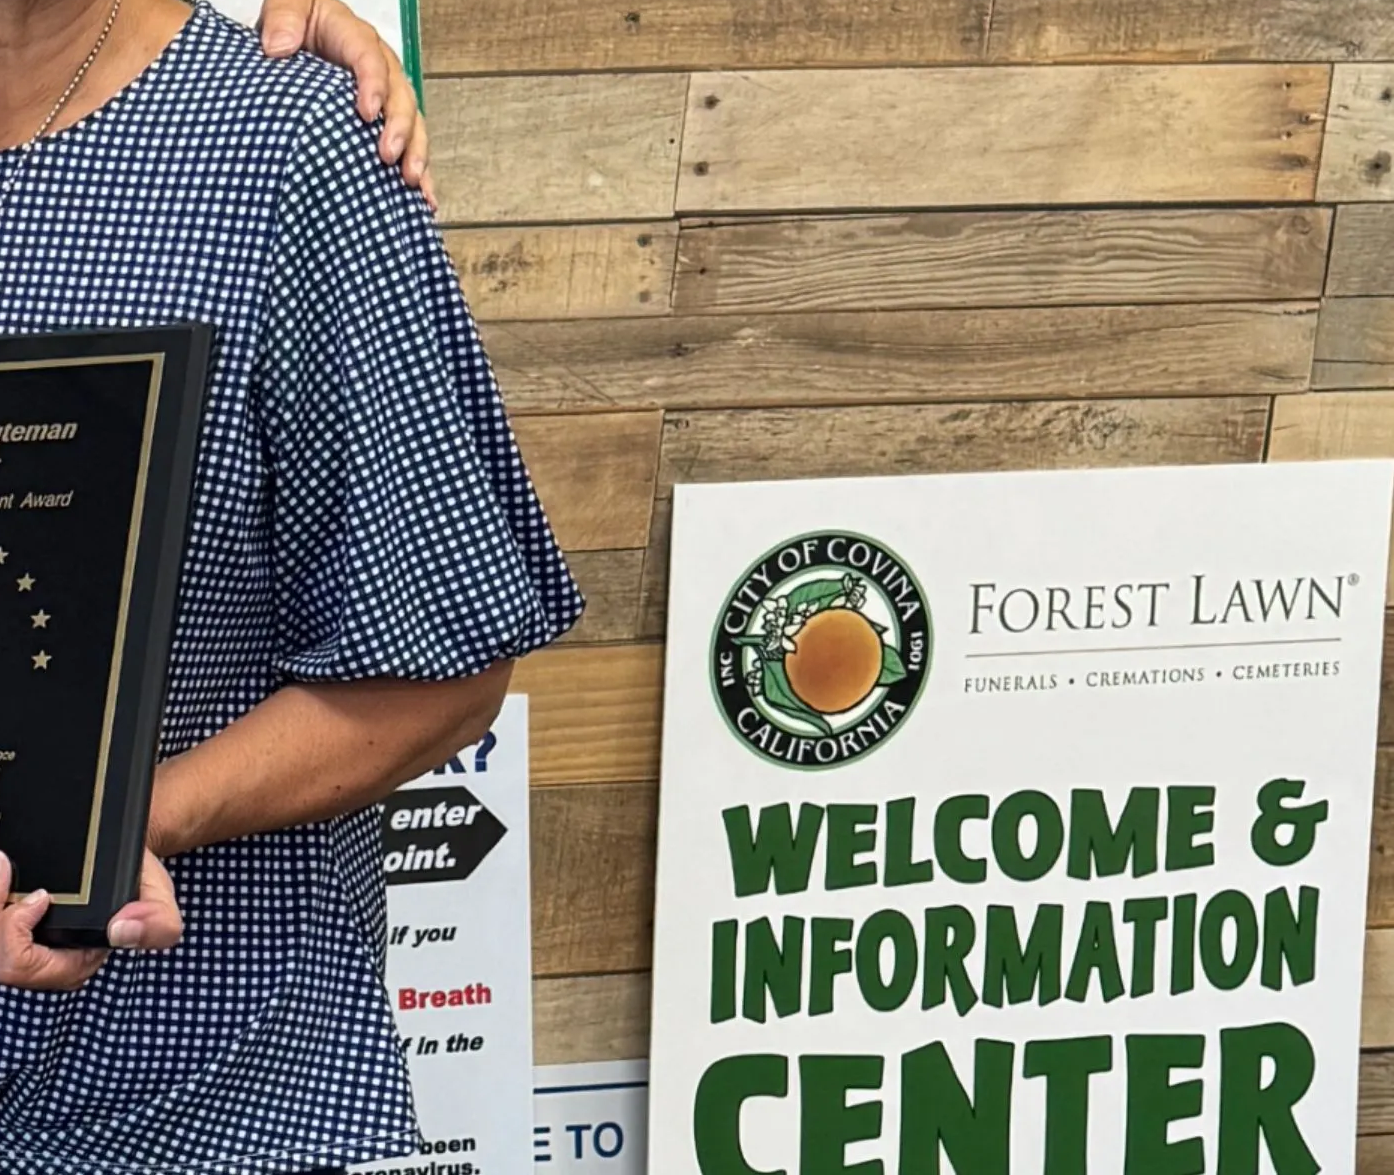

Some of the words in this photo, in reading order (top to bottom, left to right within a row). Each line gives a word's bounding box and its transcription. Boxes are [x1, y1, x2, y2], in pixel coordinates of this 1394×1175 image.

[20, 490, 74, 508] Award
[723, 563, 775, 635] CITY
[777, 539, 820, 573] OF
[826, 537, 921, 623] COVINA
[967, 582, 1171, 636] FOREST
[720, 651, 736, 687] INC
[908, 631, 925, 672] 1901
[962, 674, 1059, 694] FUNERALS
[1085, 668, 1206, 689] CREMATIONS
[1232, 661, 1342, 682] CEMETERIES
[736, 699, 908, 764] CALIFORNIA
[390, 800, 483, 831] enter
[721, 784, 1217, 898] WELCOME
[1250, 777, 1329, 867] &
[382, 841, 457, 873] oint.
[411, 926, 457, 948] you
[710, 885, 1321, 1025] INFORMATION
[398, 982, 492, 1011] Breath
[416, 1036, 439, 1056] in
[445, 1032, 484, 1054] the
[693, 1022, 1323, 1175] CENTER
[419, 1137, 477, 1156] been
[564, 1121, 624, 1160] TO
